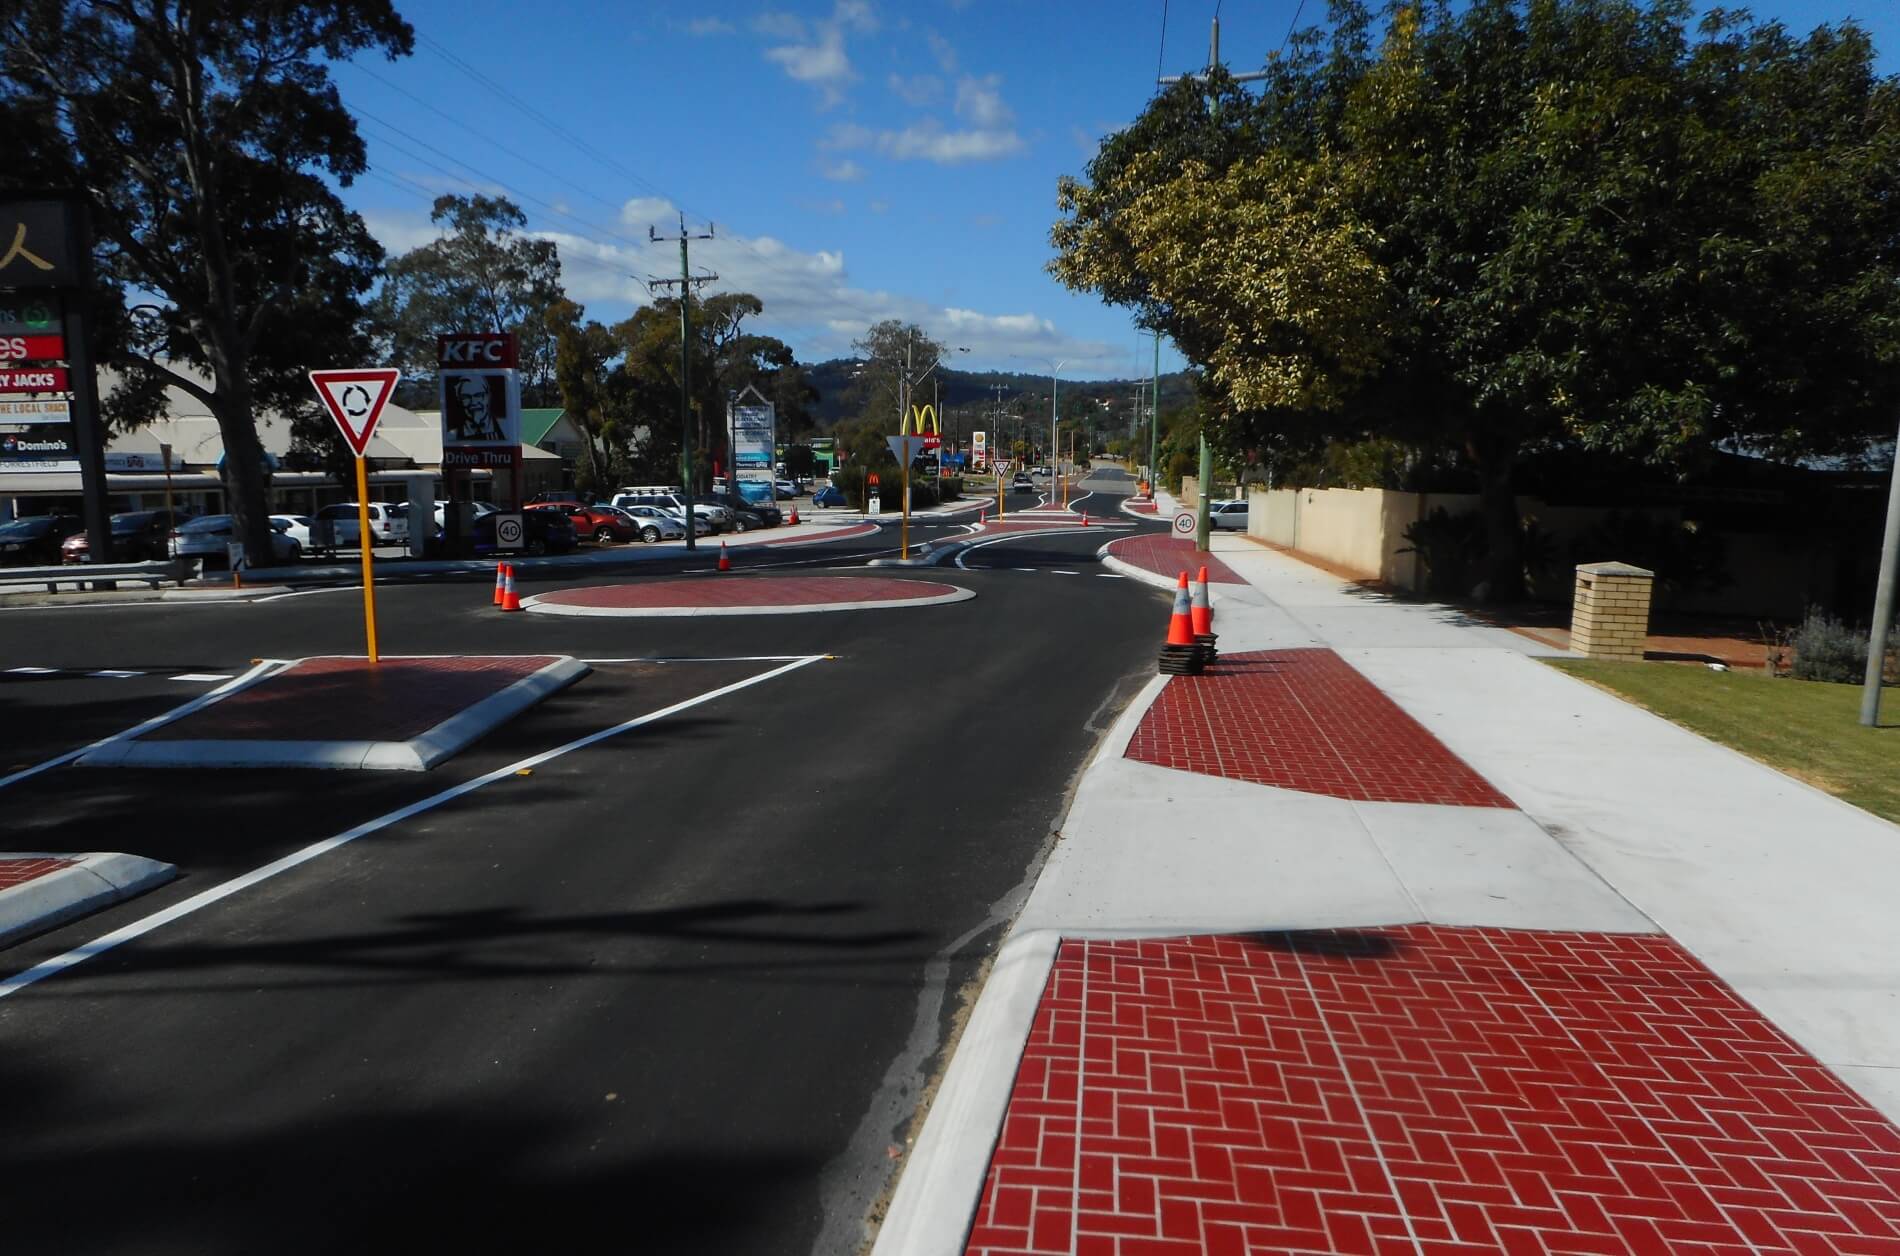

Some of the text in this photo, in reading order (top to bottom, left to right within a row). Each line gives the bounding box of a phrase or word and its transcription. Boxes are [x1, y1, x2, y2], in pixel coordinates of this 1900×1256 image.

[440, 339, 504, 362] KFC
[12, 373, 55, 387] JACKS
[14, 403, 41, 414] LOCAL
[17, 439, 68, 452] Domino's
[445, 451, 511, 464] Drive Thru
[1179, 518, 1192, 528] 40
[502, 525, 518, 537] 40
